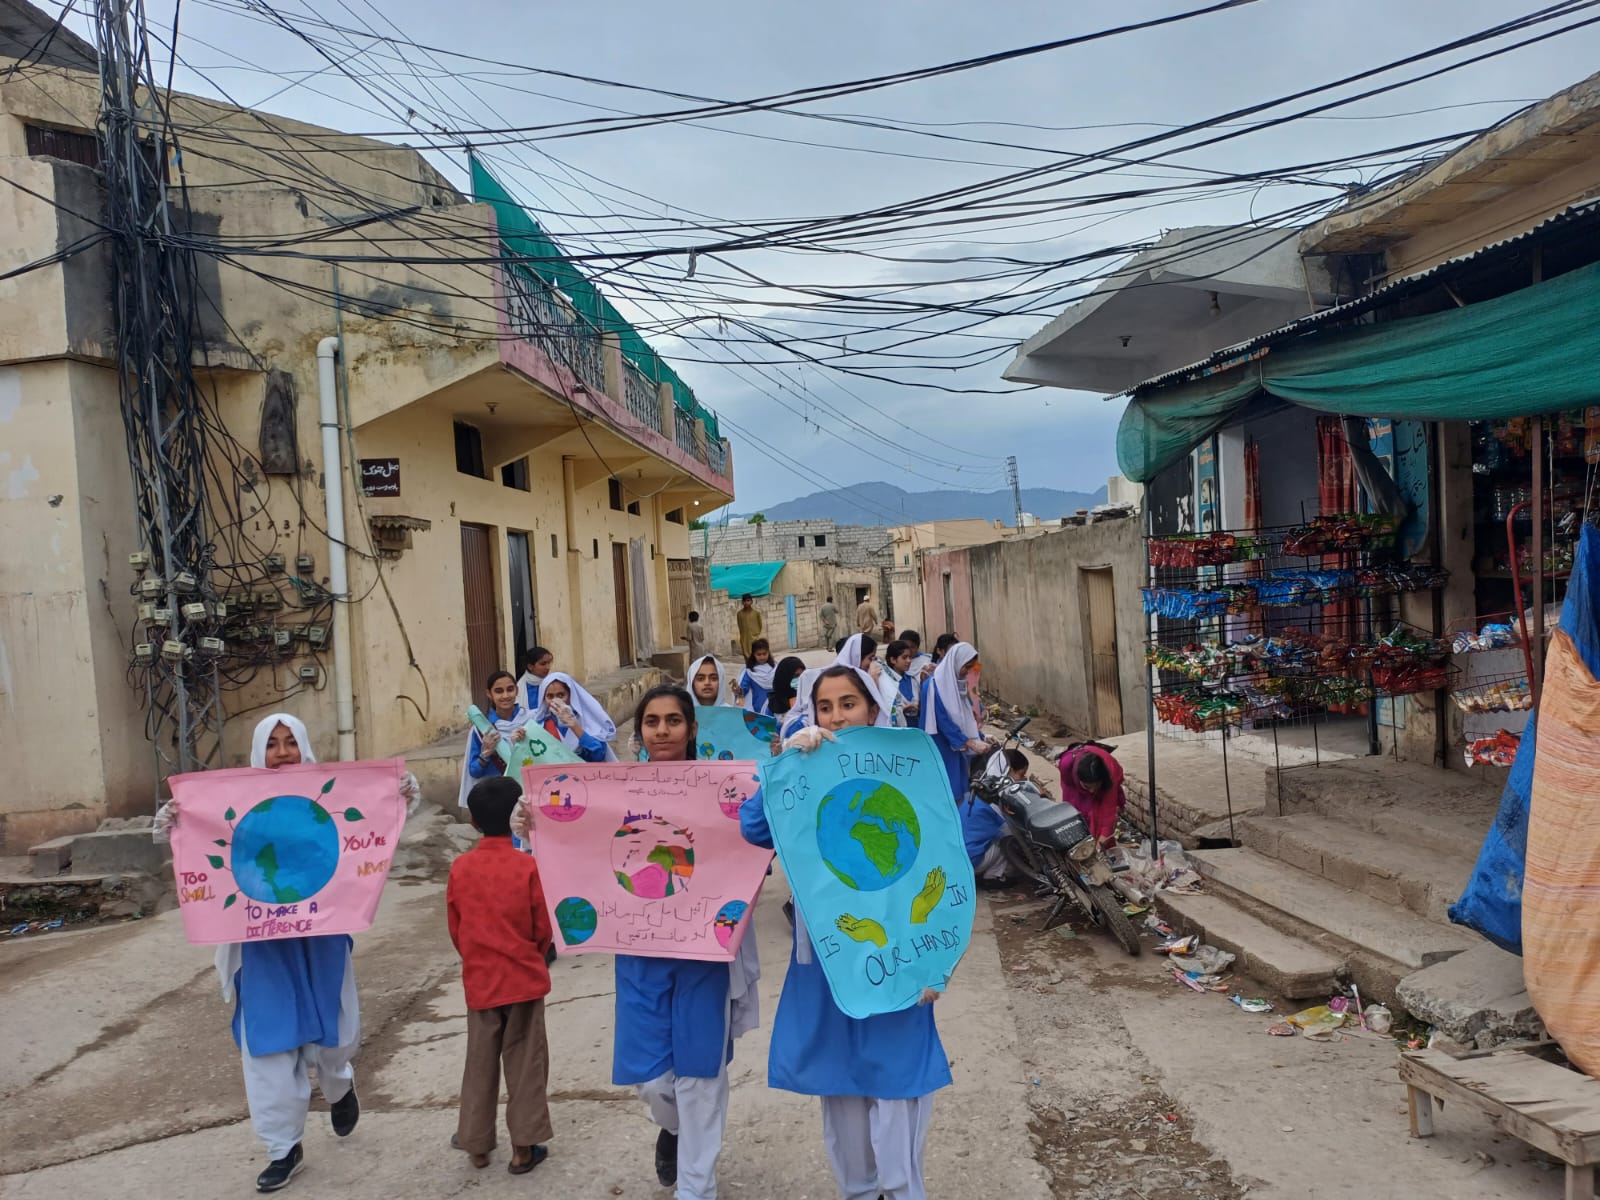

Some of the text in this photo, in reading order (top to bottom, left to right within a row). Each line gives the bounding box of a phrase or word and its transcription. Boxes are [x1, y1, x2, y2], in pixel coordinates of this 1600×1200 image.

[837, 751, 921, 779] PLANET
[343, 831, 386, 853] YOU'RE
[180, 871, 208, 886] TOO
[947, 884, 968, 907] IN
[267, 904, 299, 919] MAKE
[309, 901, 318, 914] A
[819, 934, 841, 959] IS
[865, 926, 960, 987] OUR HANDS
